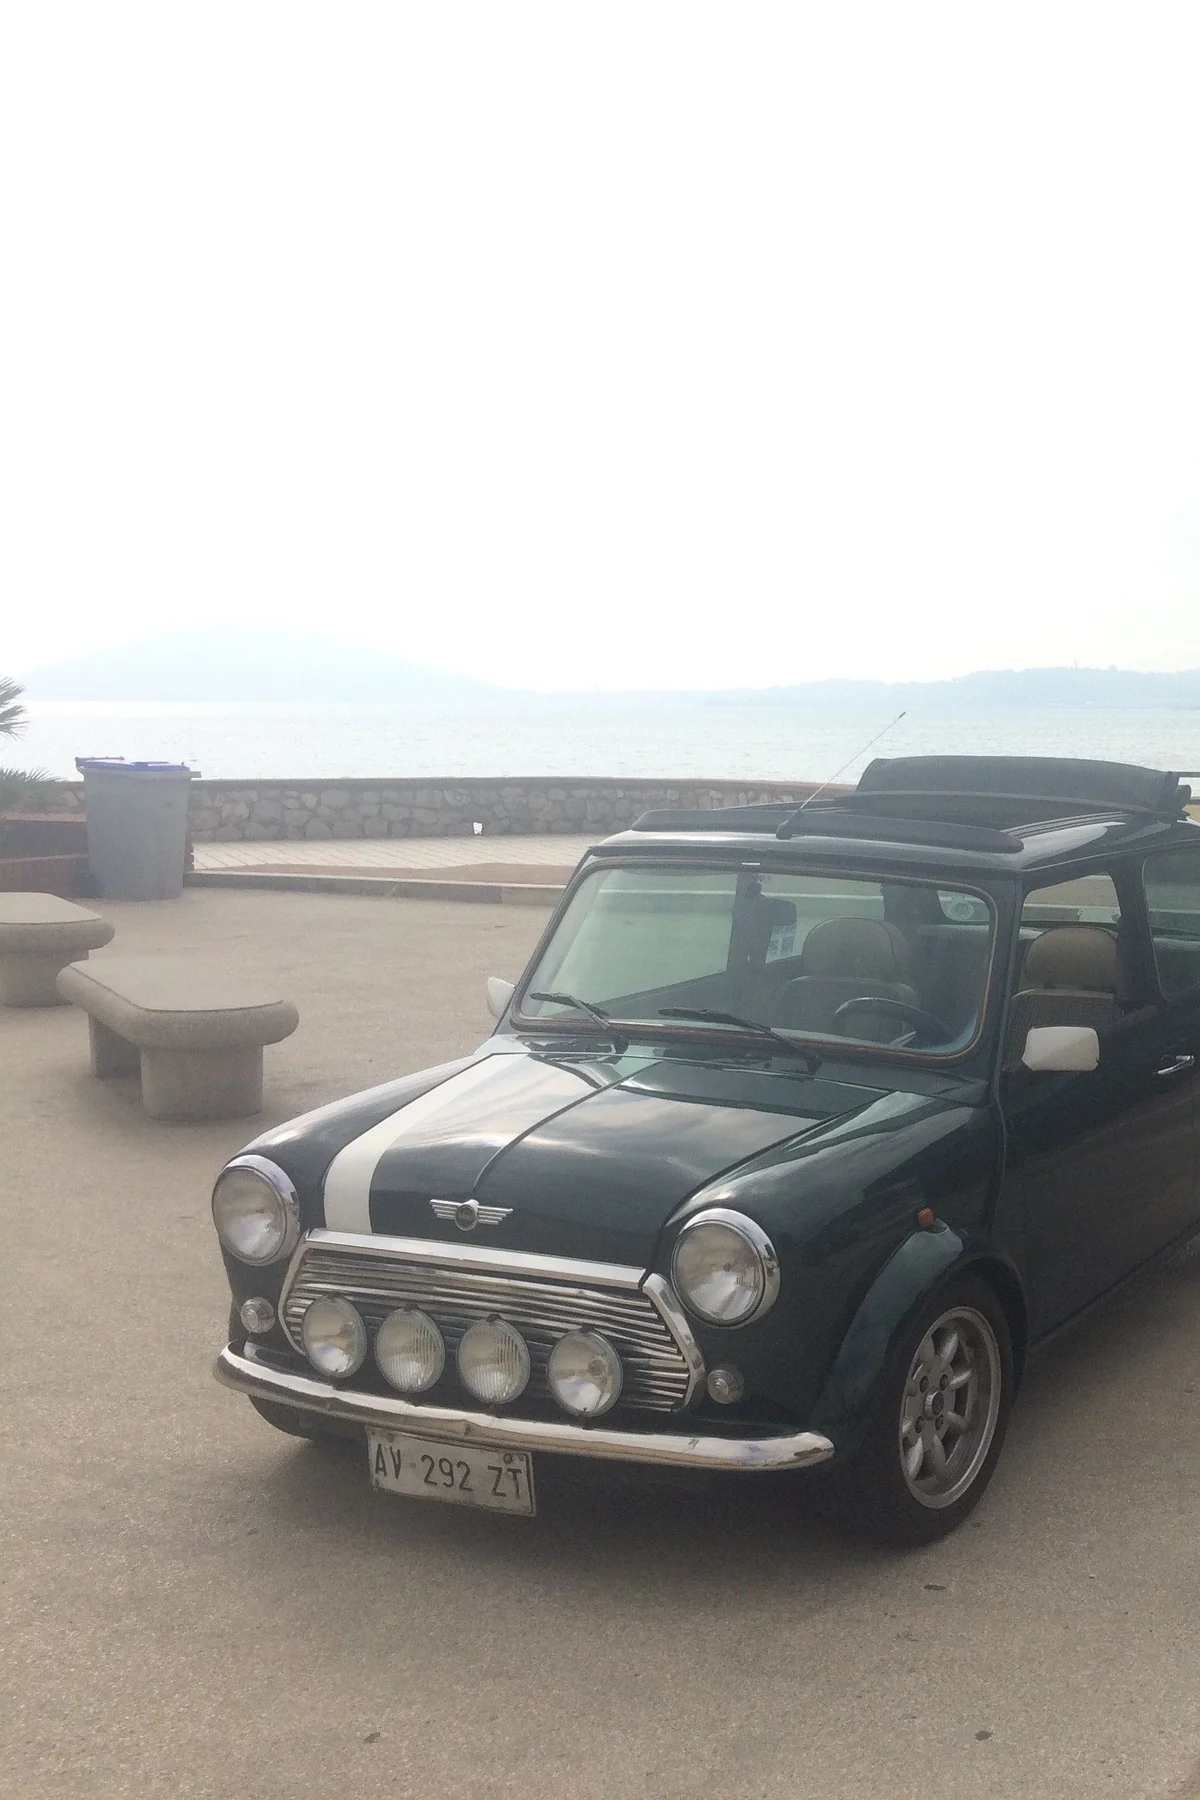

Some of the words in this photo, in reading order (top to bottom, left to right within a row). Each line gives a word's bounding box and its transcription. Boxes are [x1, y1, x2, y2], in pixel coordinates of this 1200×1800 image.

[375, 1442, 401, 1480] AV
[421, 1453, 474, 1493] 292
[487, 1464, 522, 1500] ZT
